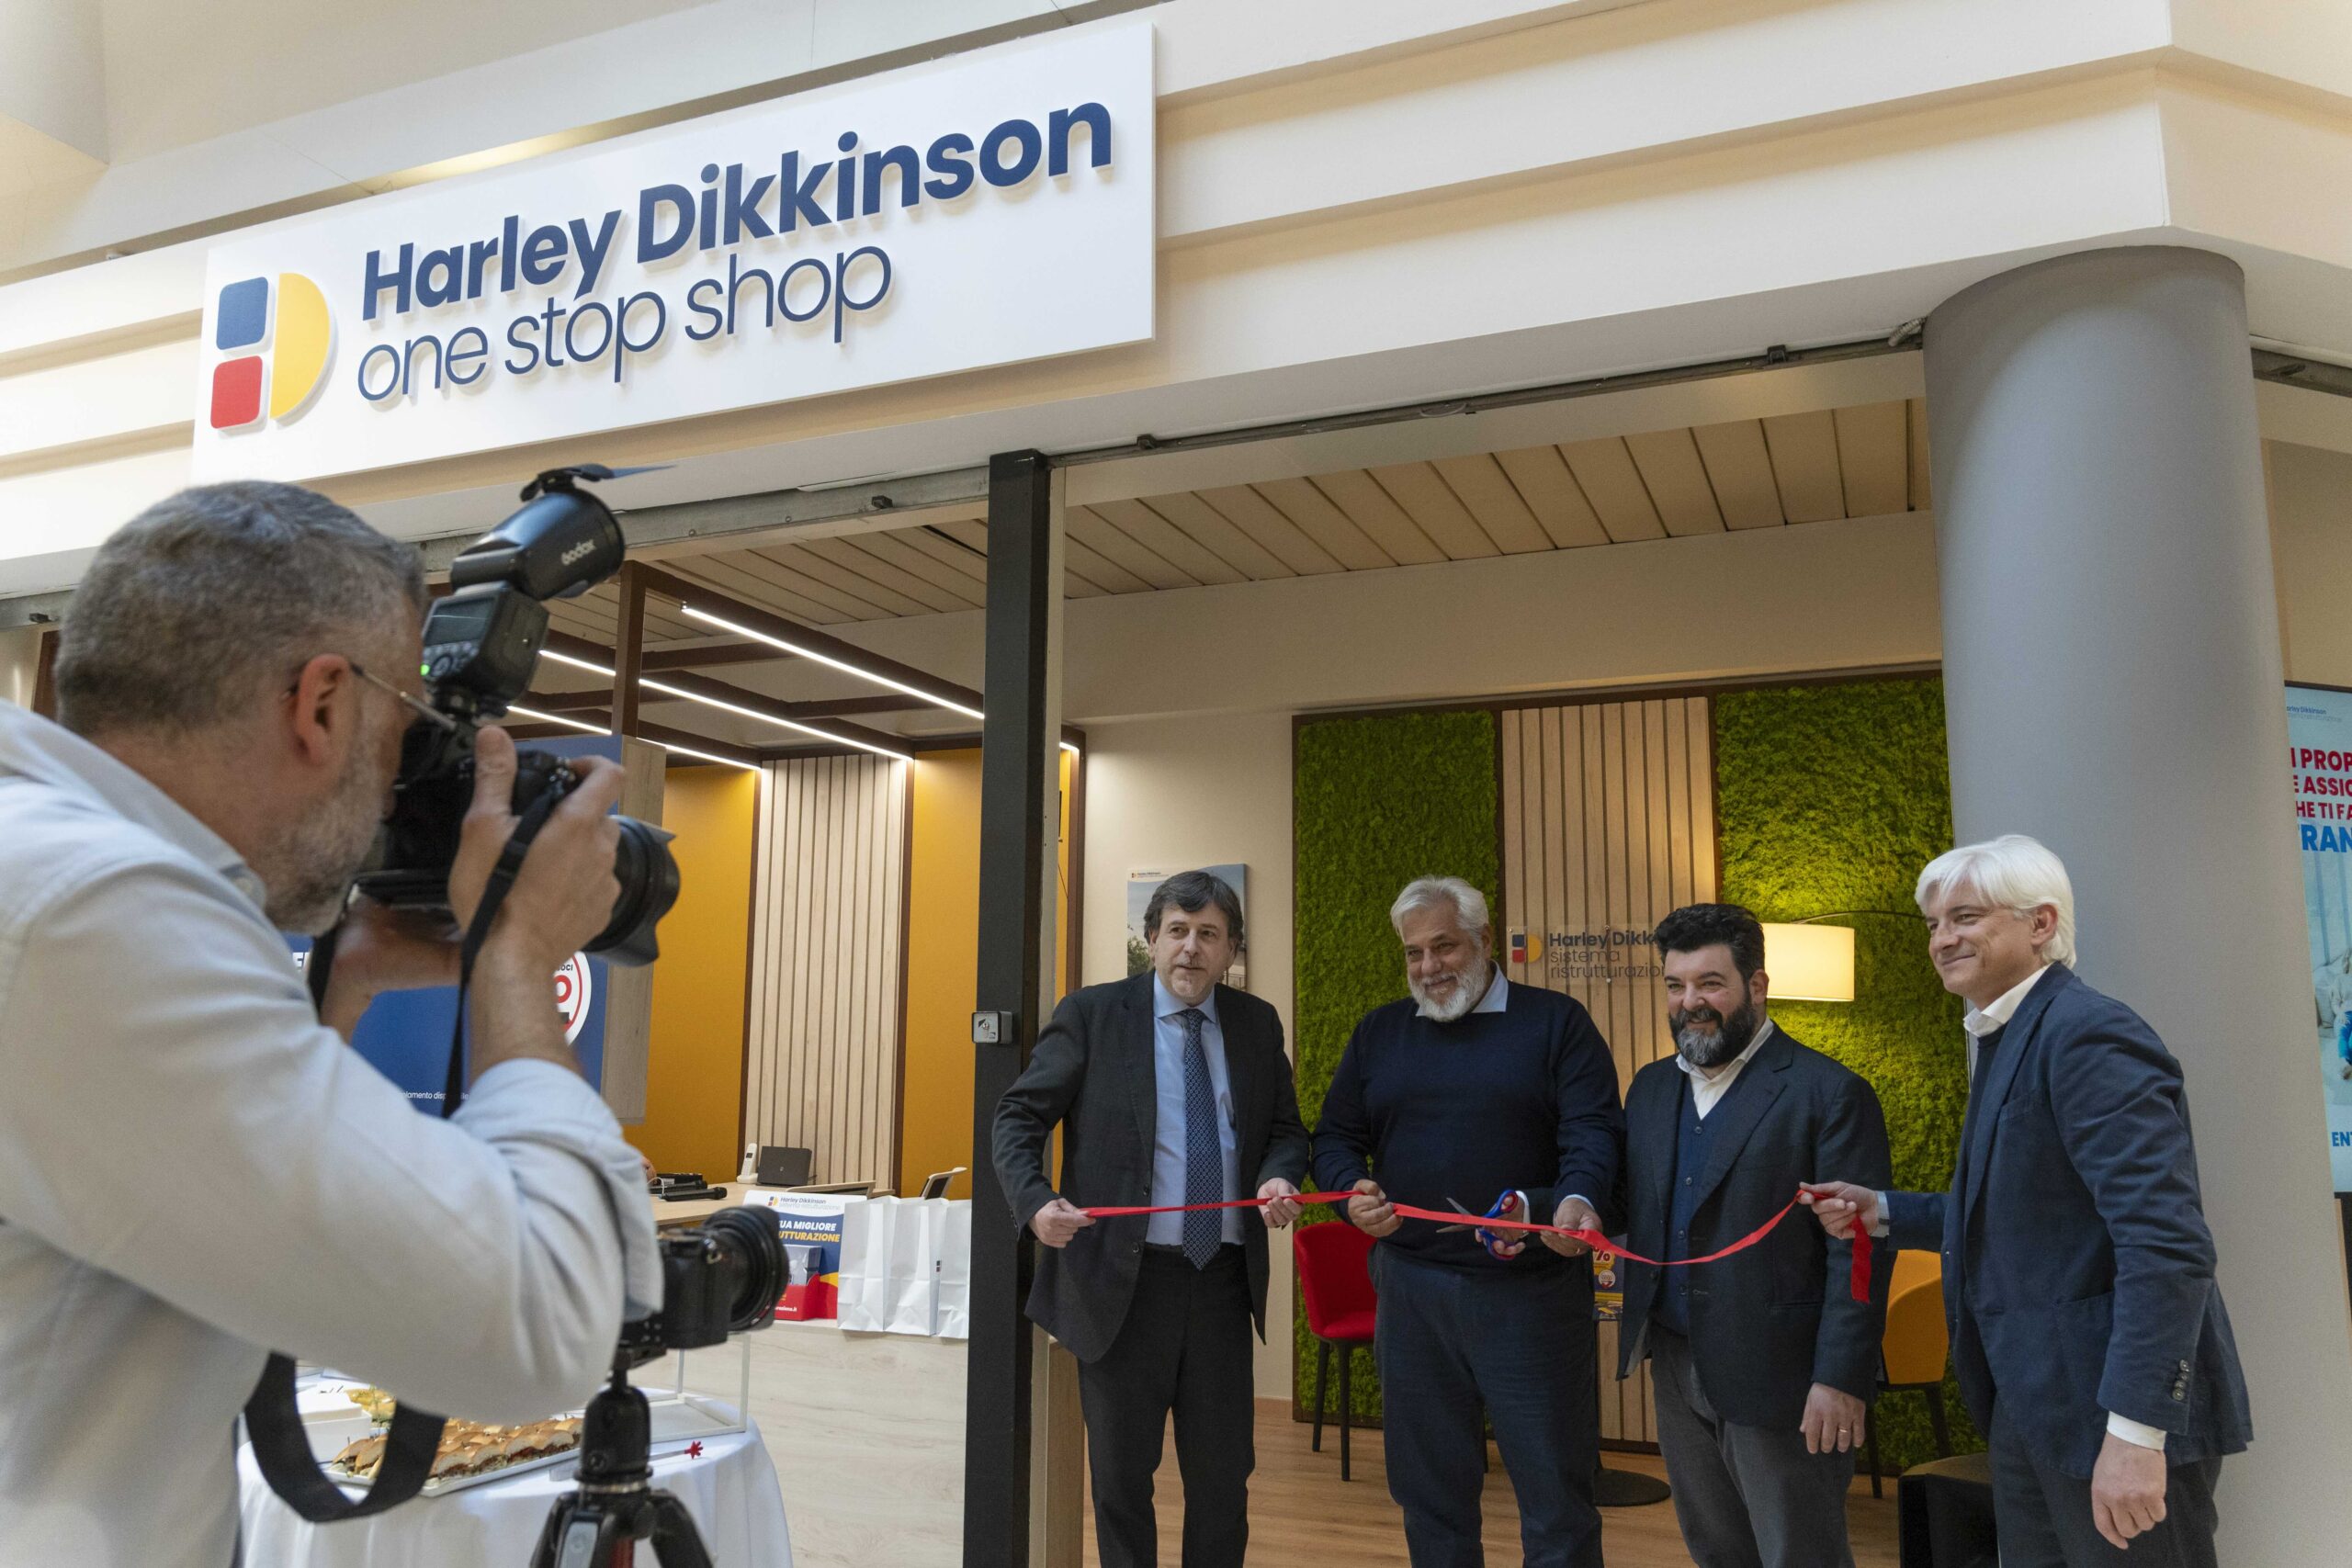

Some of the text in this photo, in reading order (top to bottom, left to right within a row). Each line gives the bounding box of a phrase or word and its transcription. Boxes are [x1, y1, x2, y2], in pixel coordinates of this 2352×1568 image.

[362, 102, 1113, 321] Harley Dikkinson
[357, 245, 891, 400] one stop shop
[2298, 823, 2352, 852] RAN
[1549, 931, 1608, 949] Harley
[1550, 948, 1621, 964] sistema
[2331, 1131, 2352, 1147] EN
[779, 1220, 837, 1232] UA MIGLIORE
